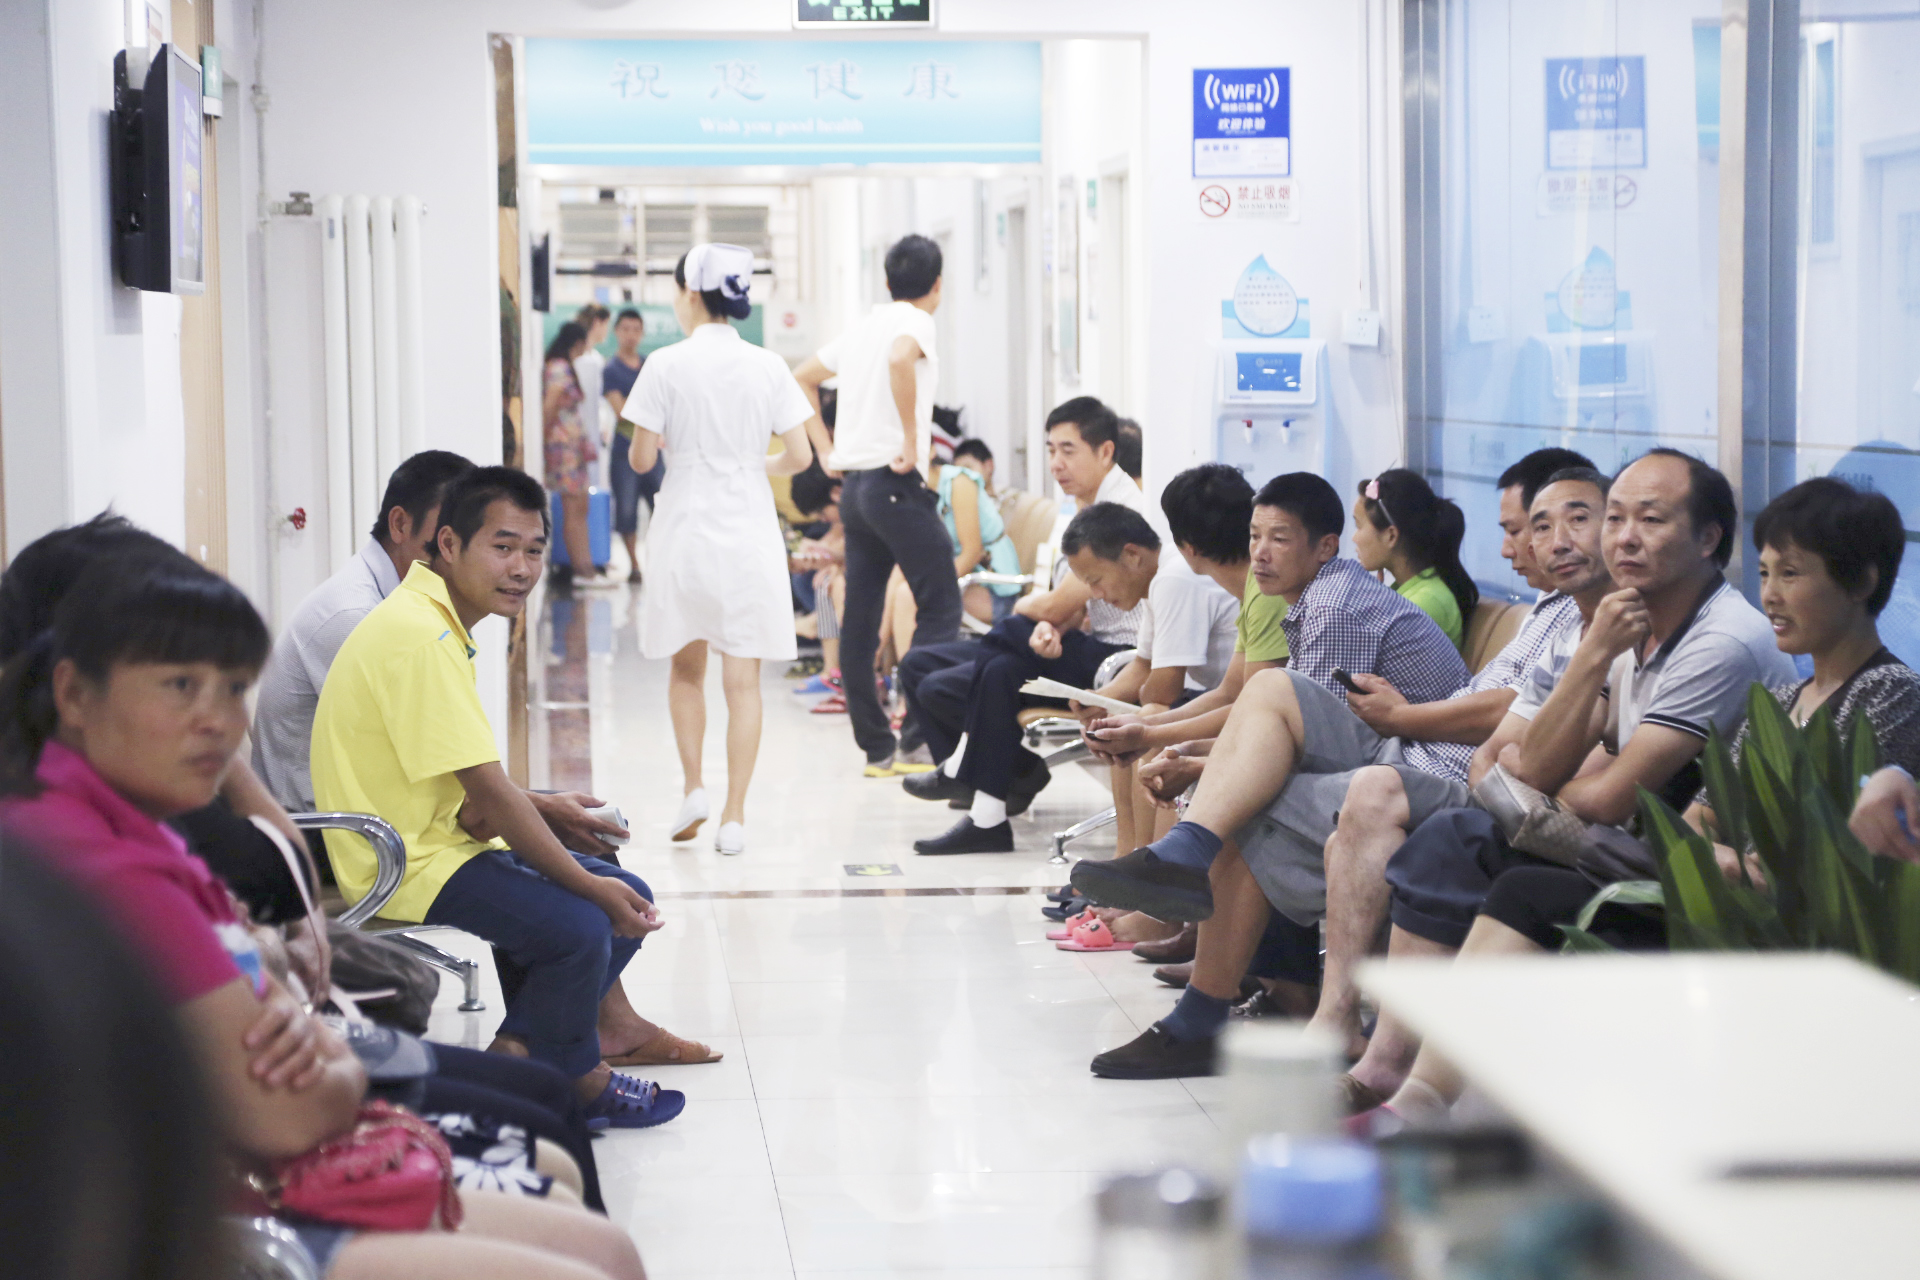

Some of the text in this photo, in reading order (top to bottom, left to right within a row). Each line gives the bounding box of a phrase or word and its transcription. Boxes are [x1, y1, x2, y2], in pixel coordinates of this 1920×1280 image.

[833, 6, 894, 20] EXIT
[609, 58, 961, 102] 祝您健康
[700, 117, 864, 137] Wish you good health
[1238, 184, 1290, 201] 禁止吸烟
